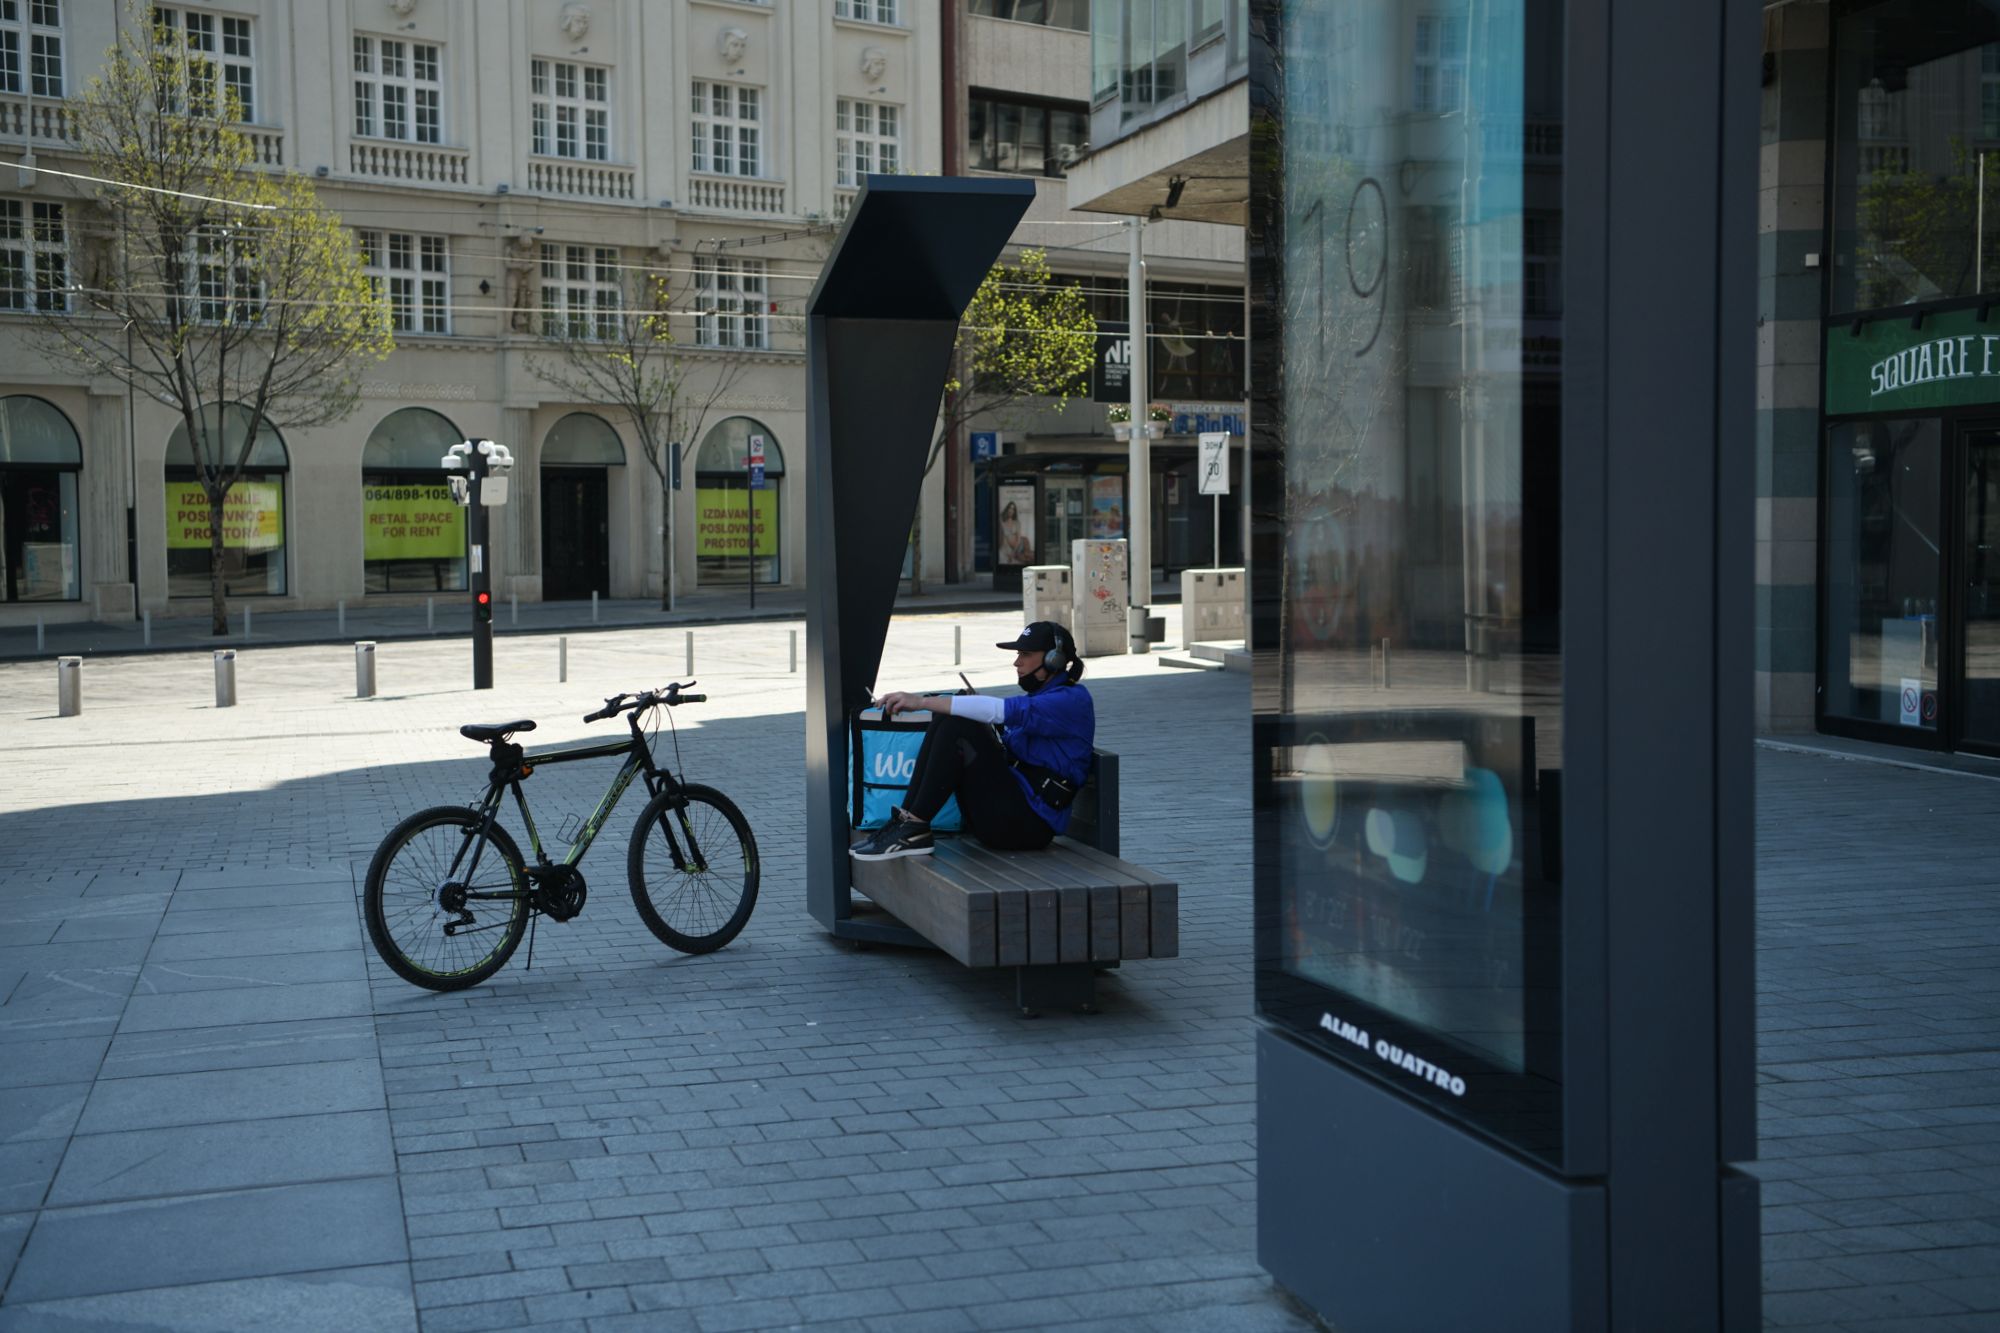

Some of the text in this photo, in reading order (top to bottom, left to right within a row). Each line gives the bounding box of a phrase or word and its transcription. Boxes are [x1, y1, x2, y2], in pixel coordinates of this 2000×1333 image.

[1870, 335, 1976, 395] SQUARE
[1207, 462, 1220, 476] 30
[181, 493, 261, 505] IZDANJE
[366, 488, 453, 501] 064/898-105
[177, 511, 267, 523] POSLVNOG
[369, 512, 454, 525] RETAIL SPACE
[703, 508, 761, 519] IZDAVANE
[184, 527, 260, 539] PROTORA
[383, 526, 443, 538] FOR RENT
[1318, 1012, 1466, 1097] ALMA QUATTRO
